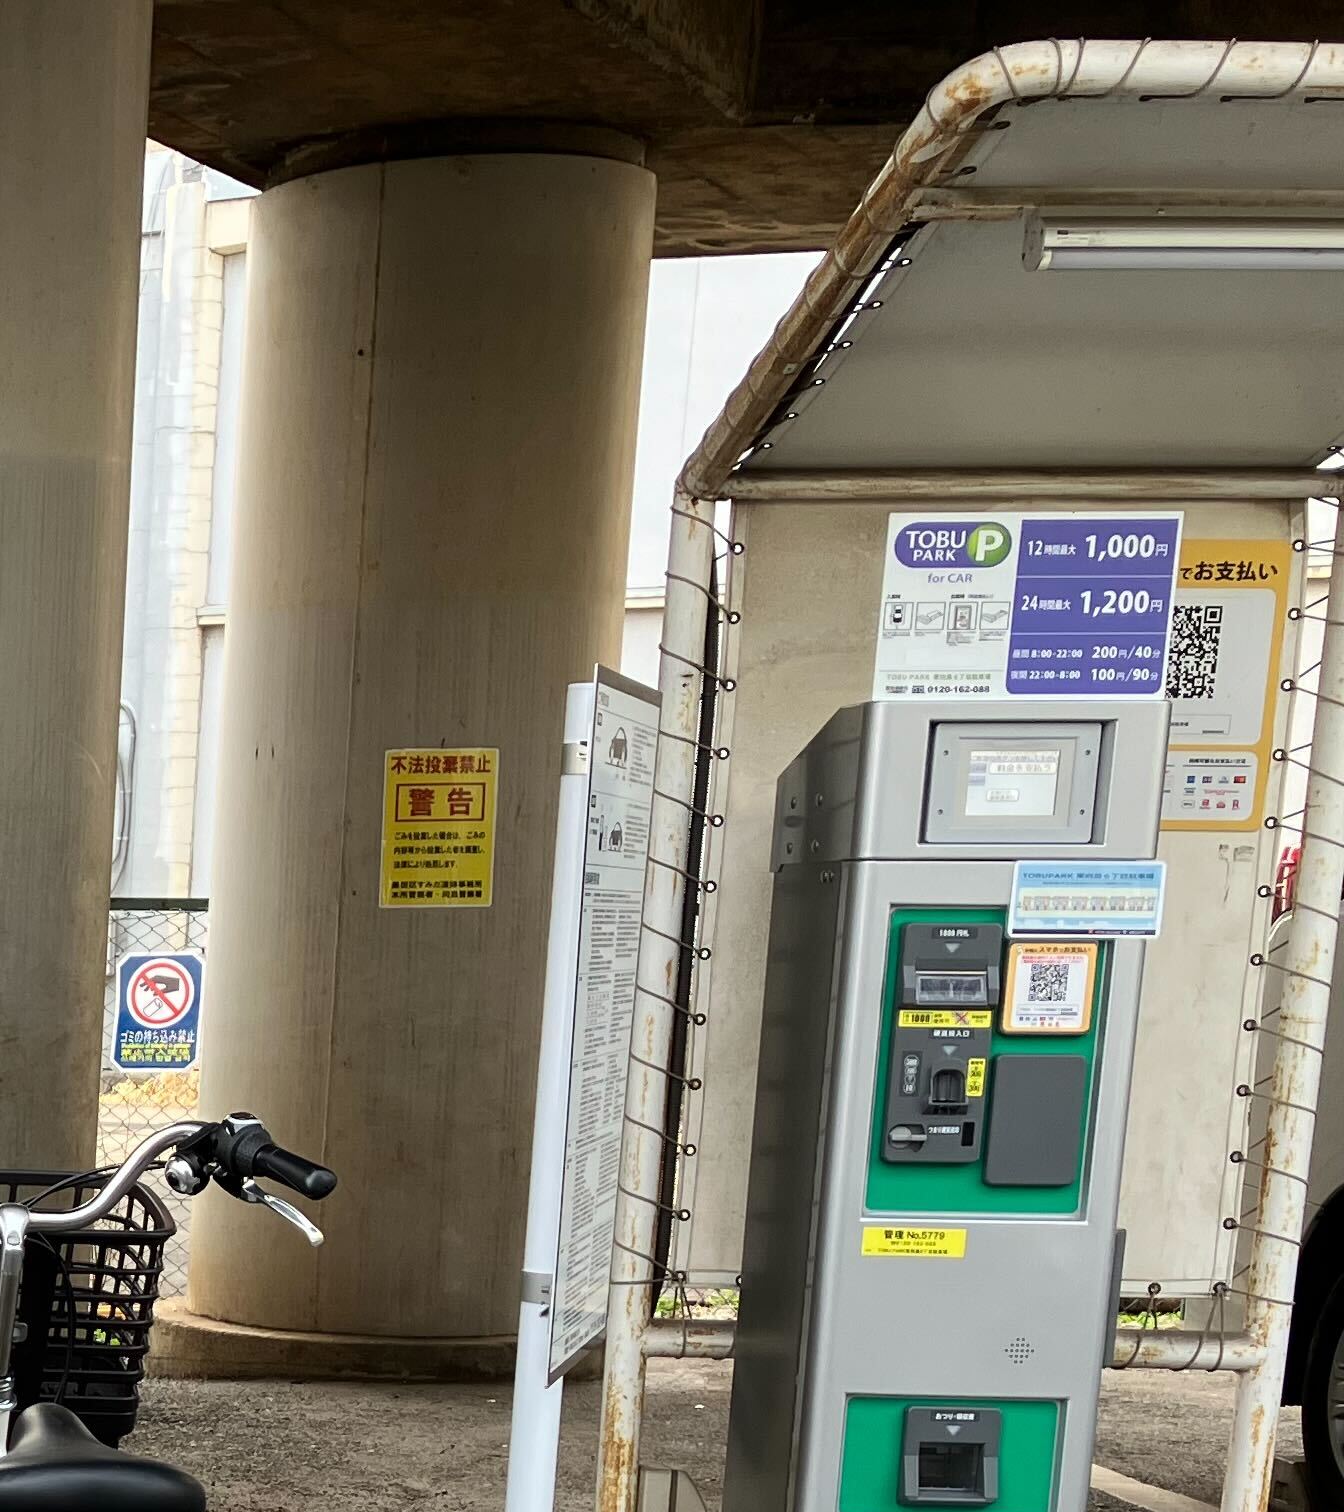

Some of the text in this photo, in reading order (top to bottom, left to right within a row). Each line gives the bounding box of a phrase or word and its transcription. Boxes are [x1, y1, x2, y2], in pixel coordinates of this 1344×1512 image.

[905, 529, 967, 549] TOBU
[1085, 534, 1168, 562] 1,000円
[913, 549, 956, 561] PARK
[927, 573, 973, 583] for CAR
[1080, 590, 1163, 617] 1,200円
[391, 754, 491, 775] 不法投棄禁止
[408, 787, 474, 817] 警告
